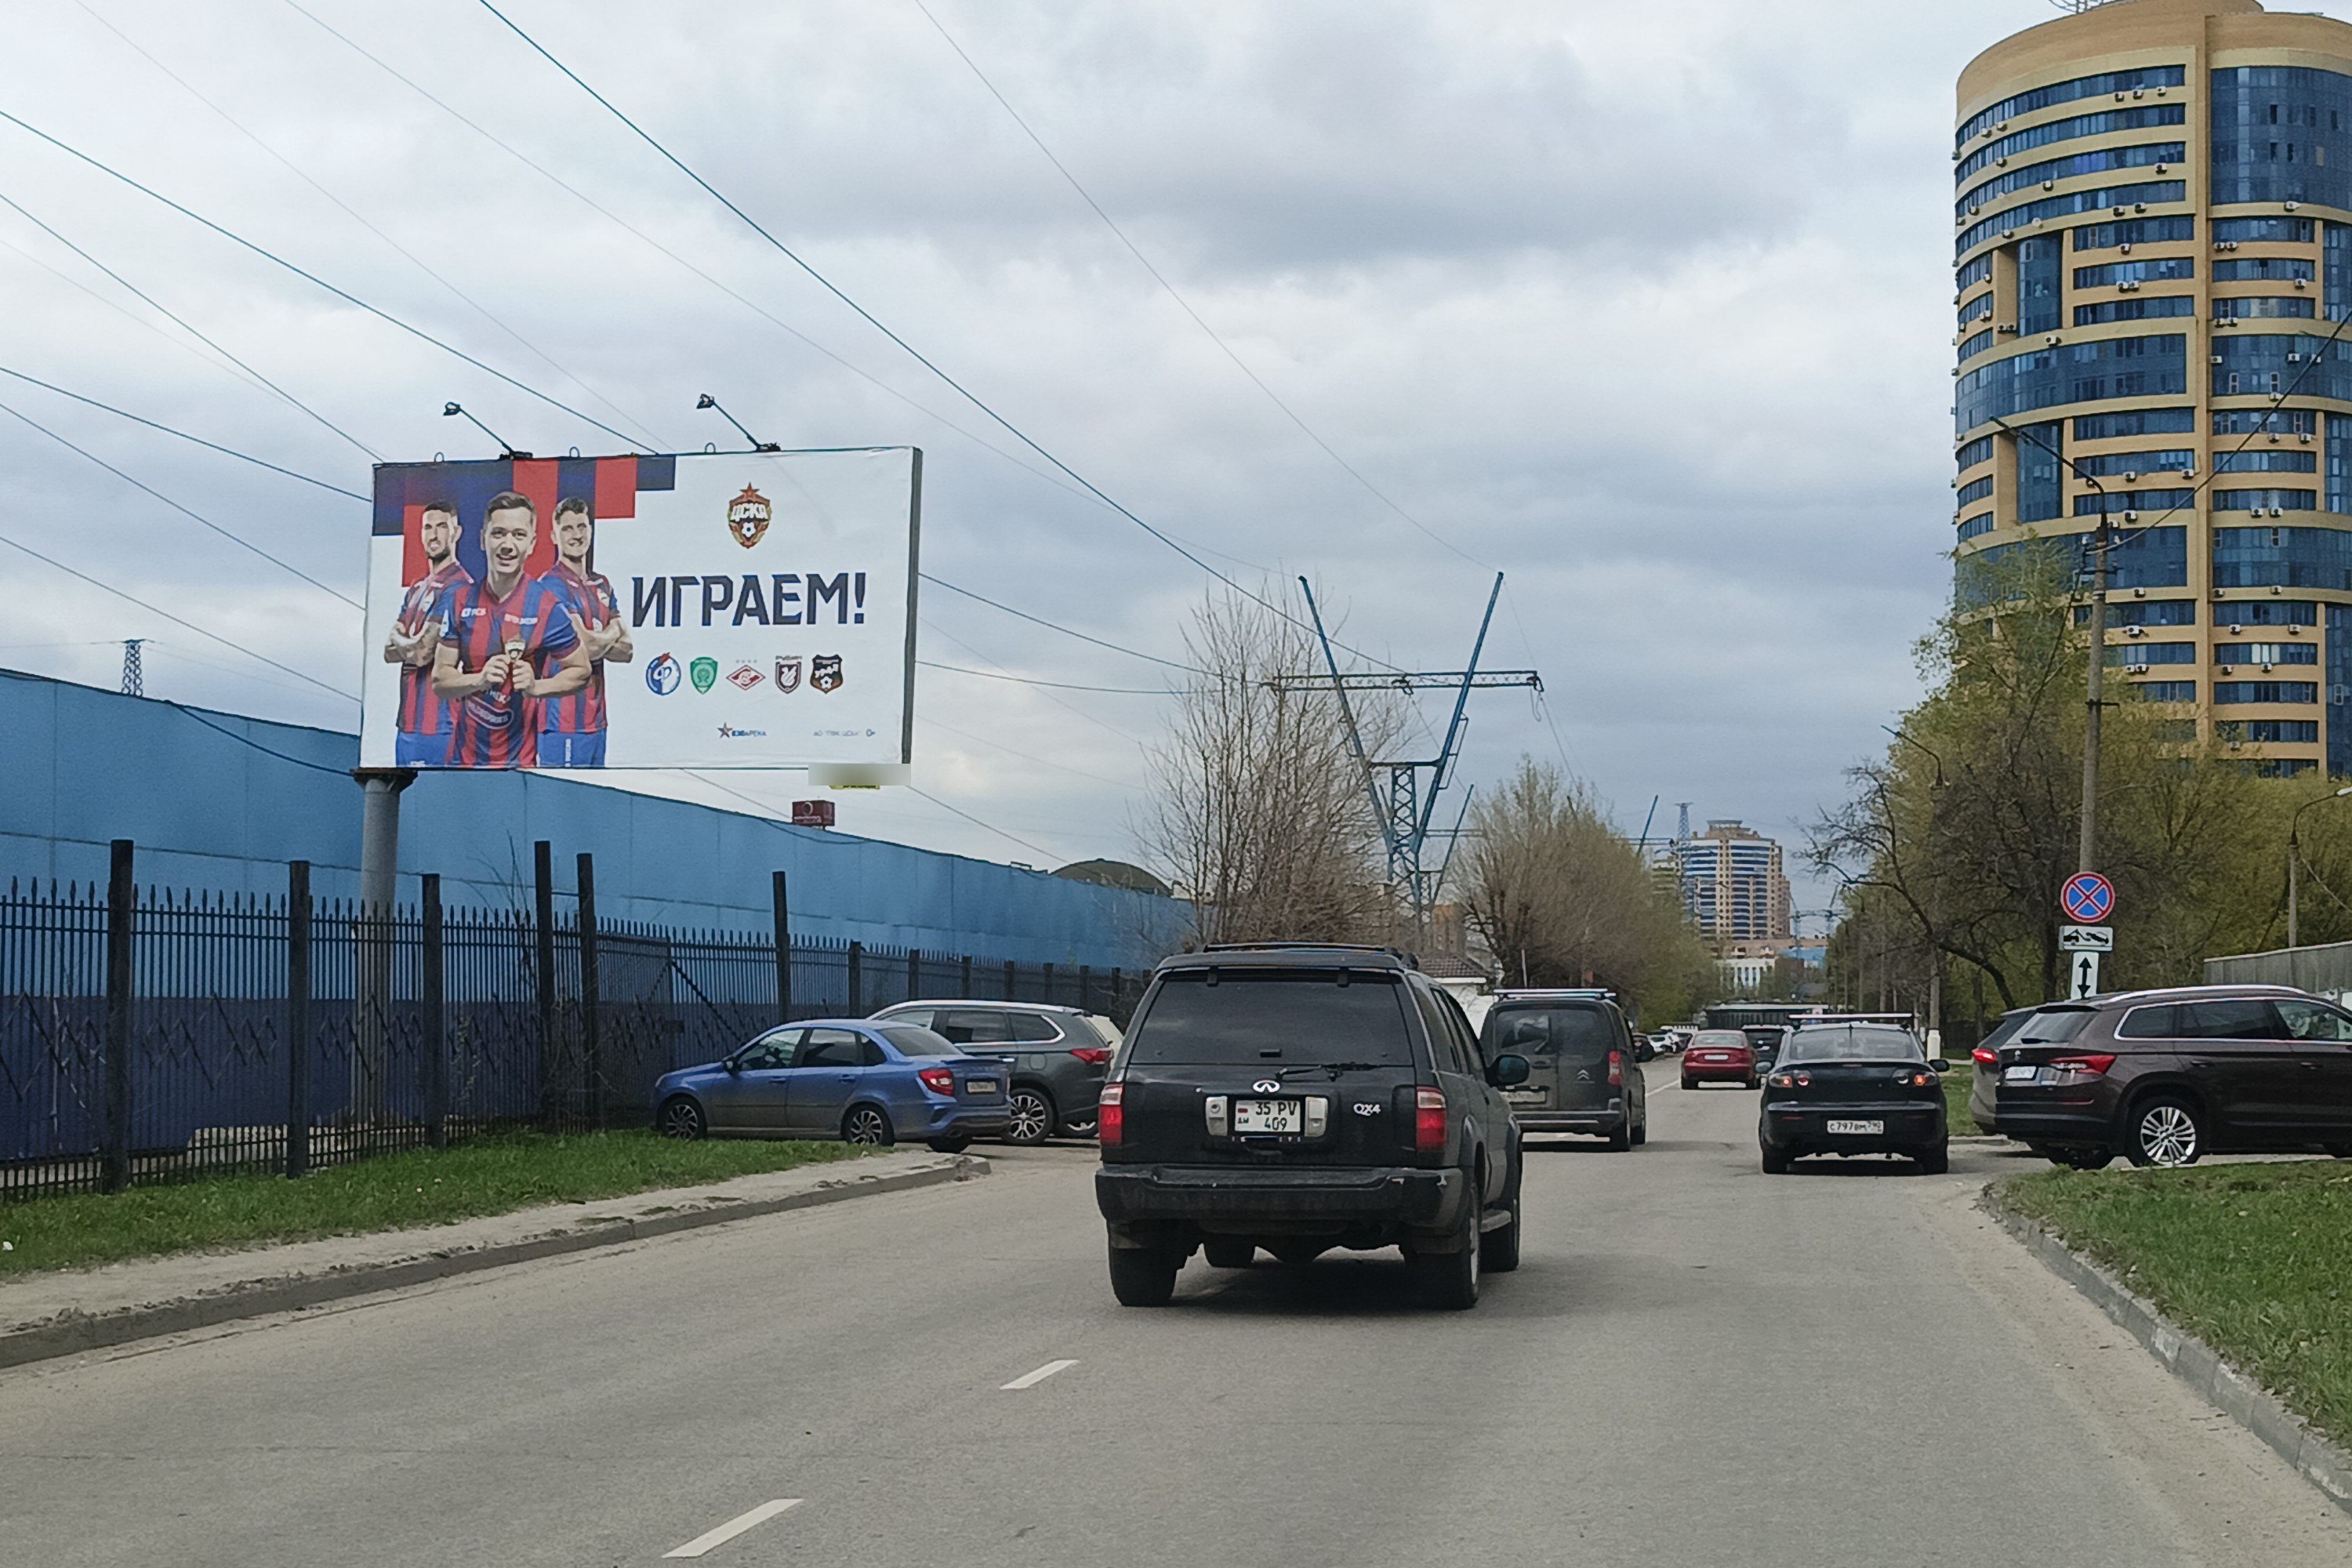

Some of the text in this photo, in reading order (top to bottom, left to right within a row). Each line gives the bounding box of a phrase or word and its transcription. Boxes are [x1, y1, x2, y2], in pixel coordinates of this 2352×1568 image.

[731, 503, 768, 521] ЦСКА
[631, 572, 866, 627] ИГРАЕМ!
[1256, 1102, 1298, 1116] 35 PV
[1353, 1103, 1381, 1116] QX4
[1264, 1116, 1288, 1131] 409
